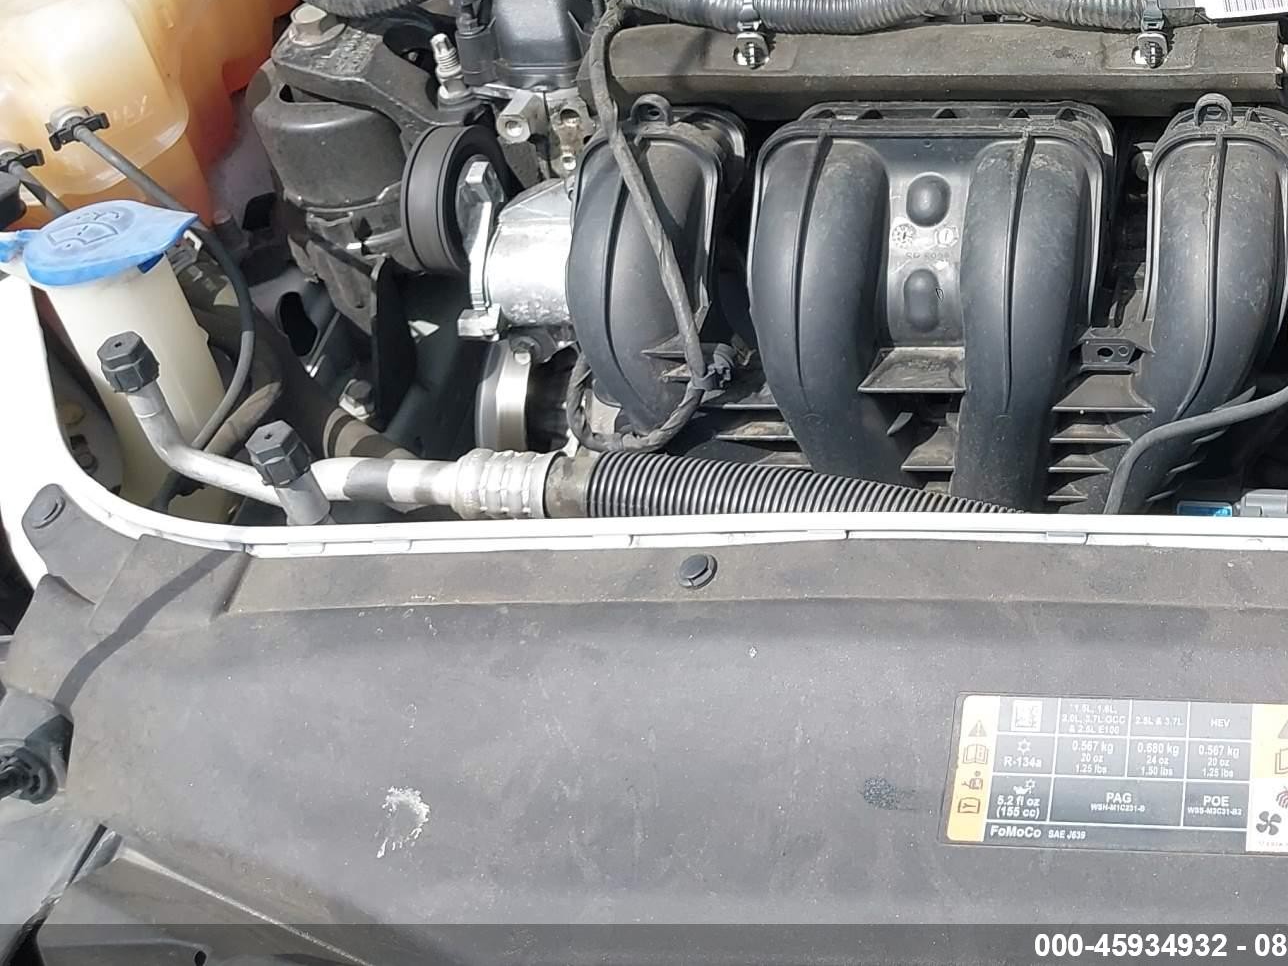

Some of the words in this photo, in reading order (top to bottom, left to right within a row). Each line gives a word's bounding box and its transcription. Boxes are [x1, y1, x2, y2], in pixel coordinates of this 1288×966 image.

[1210, 719, 1231, 727] HEV
[1072, 740, 1098, 752] 0.567
[1101, 741, 1114, 754] kg
[1137, 742, 1164, 754] 0.680
[1166, 743, 1180, 756] kg
[1199, 744, 1225, 756] 0.567
[1227, 745, 1240, 758] kg
[1003, 756, 1042, 768] R-134a
[1080, 755, 1091, 763] 20
[1146, 756, 1157, 765] 24
[1158, 757, 1169, 765] oz
[1208, 758, 1218, 766] 20
[1220, 759, 1230, 767] oz
[1075, 764, 1093, 773] 1.25
[1141, 766, 1158, 775] 1.50
[1202, 767, 1219, 777] 1.25
[997, 795, 1014, 806] 5.2
[1016, 795, 1024, 806] fl
[1026, 798, 1040, 807] oz
[1106, 792, 1132, 803] PAG
[1203, 795, 1230, 807] POE
[996, 806, 1020, 818] (155
[1022, 808, 1040, 820] cc)
[990, 825, 1042, 839] FoMoCo
[1048, 829, 1066, 839] SAE
[1066, 829, 1086, 840] J639
